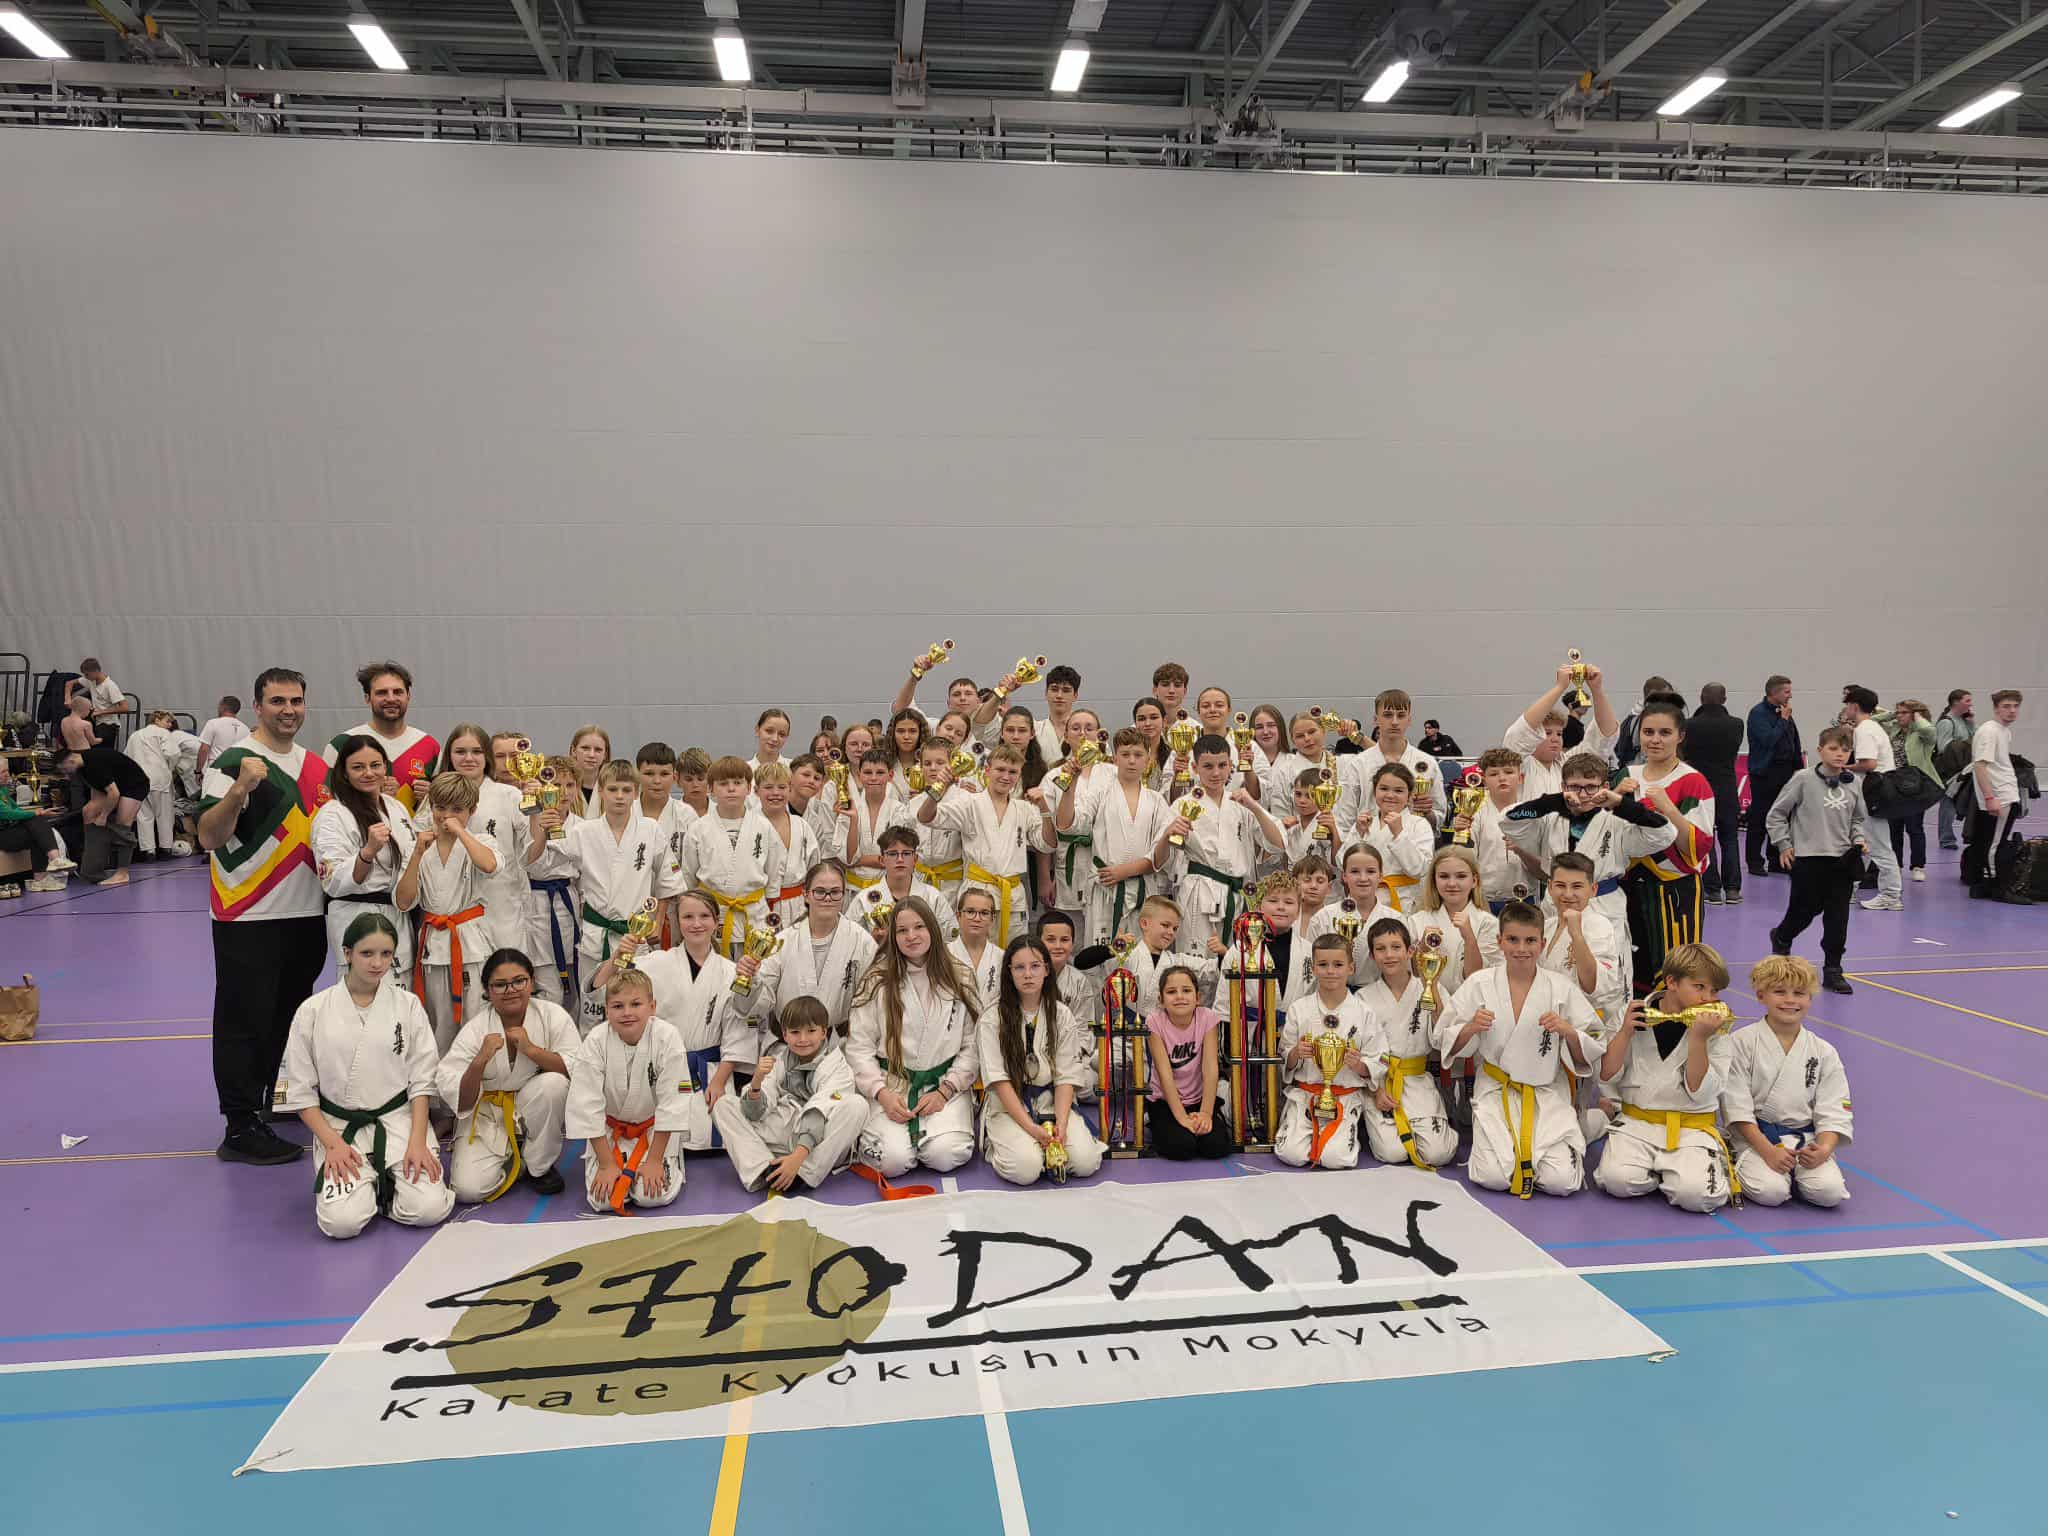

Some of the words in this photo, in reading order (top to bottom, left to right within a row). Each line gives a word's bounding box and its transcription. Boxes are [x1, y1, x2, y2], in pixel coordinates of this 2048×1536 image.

[323, 1181, 354, 1200] 210
[379, 1382, 670, 1421] Karate
[720, 1346, 1141, 1394] Kyokushin
[1182, 1317, 1490, 1356] Mokykla
